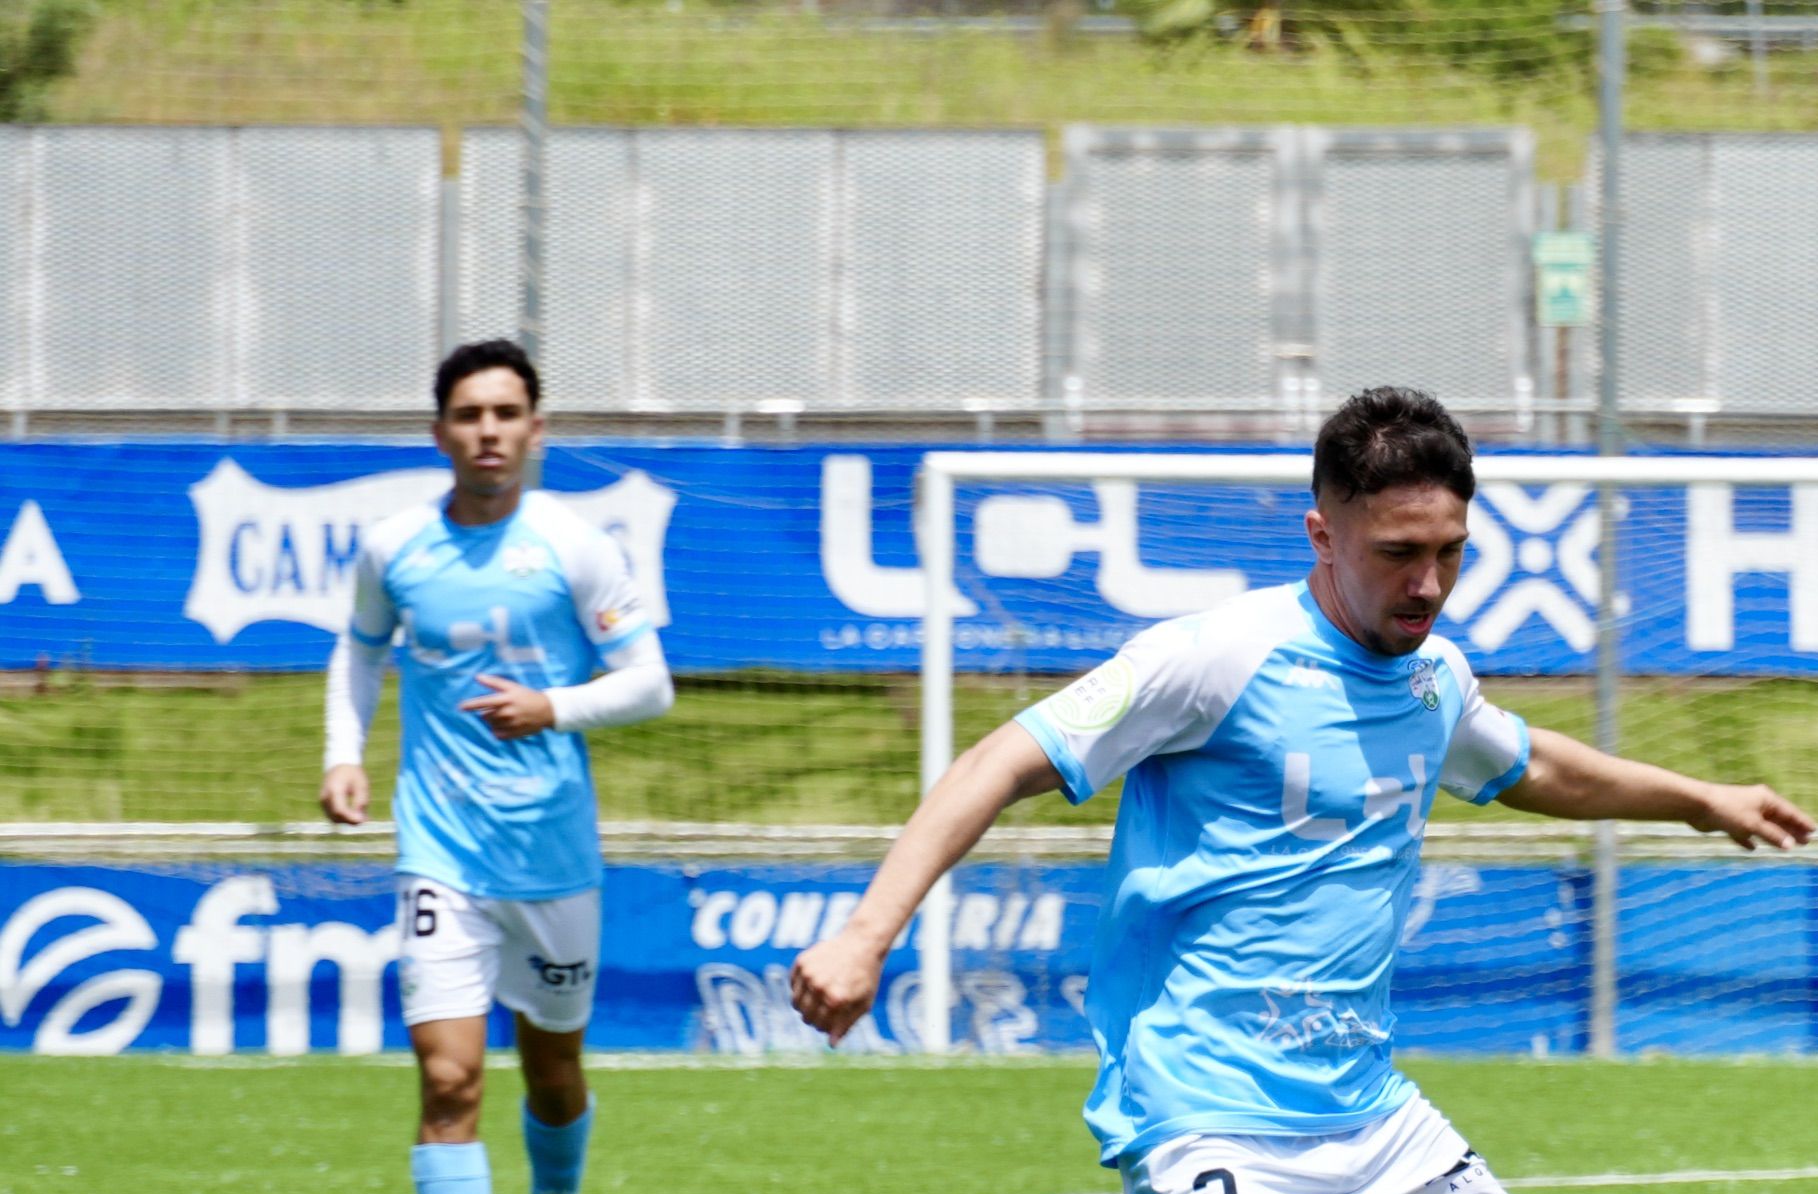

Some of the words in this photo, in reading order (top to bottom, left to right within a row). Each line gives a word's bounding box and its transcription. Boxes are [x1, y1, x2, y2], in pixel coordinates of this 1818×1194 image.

[0, 498, 82, 605] A
[172, 874, 402, 1056] fm
[691, 889, 1066, 950] CONRIA
